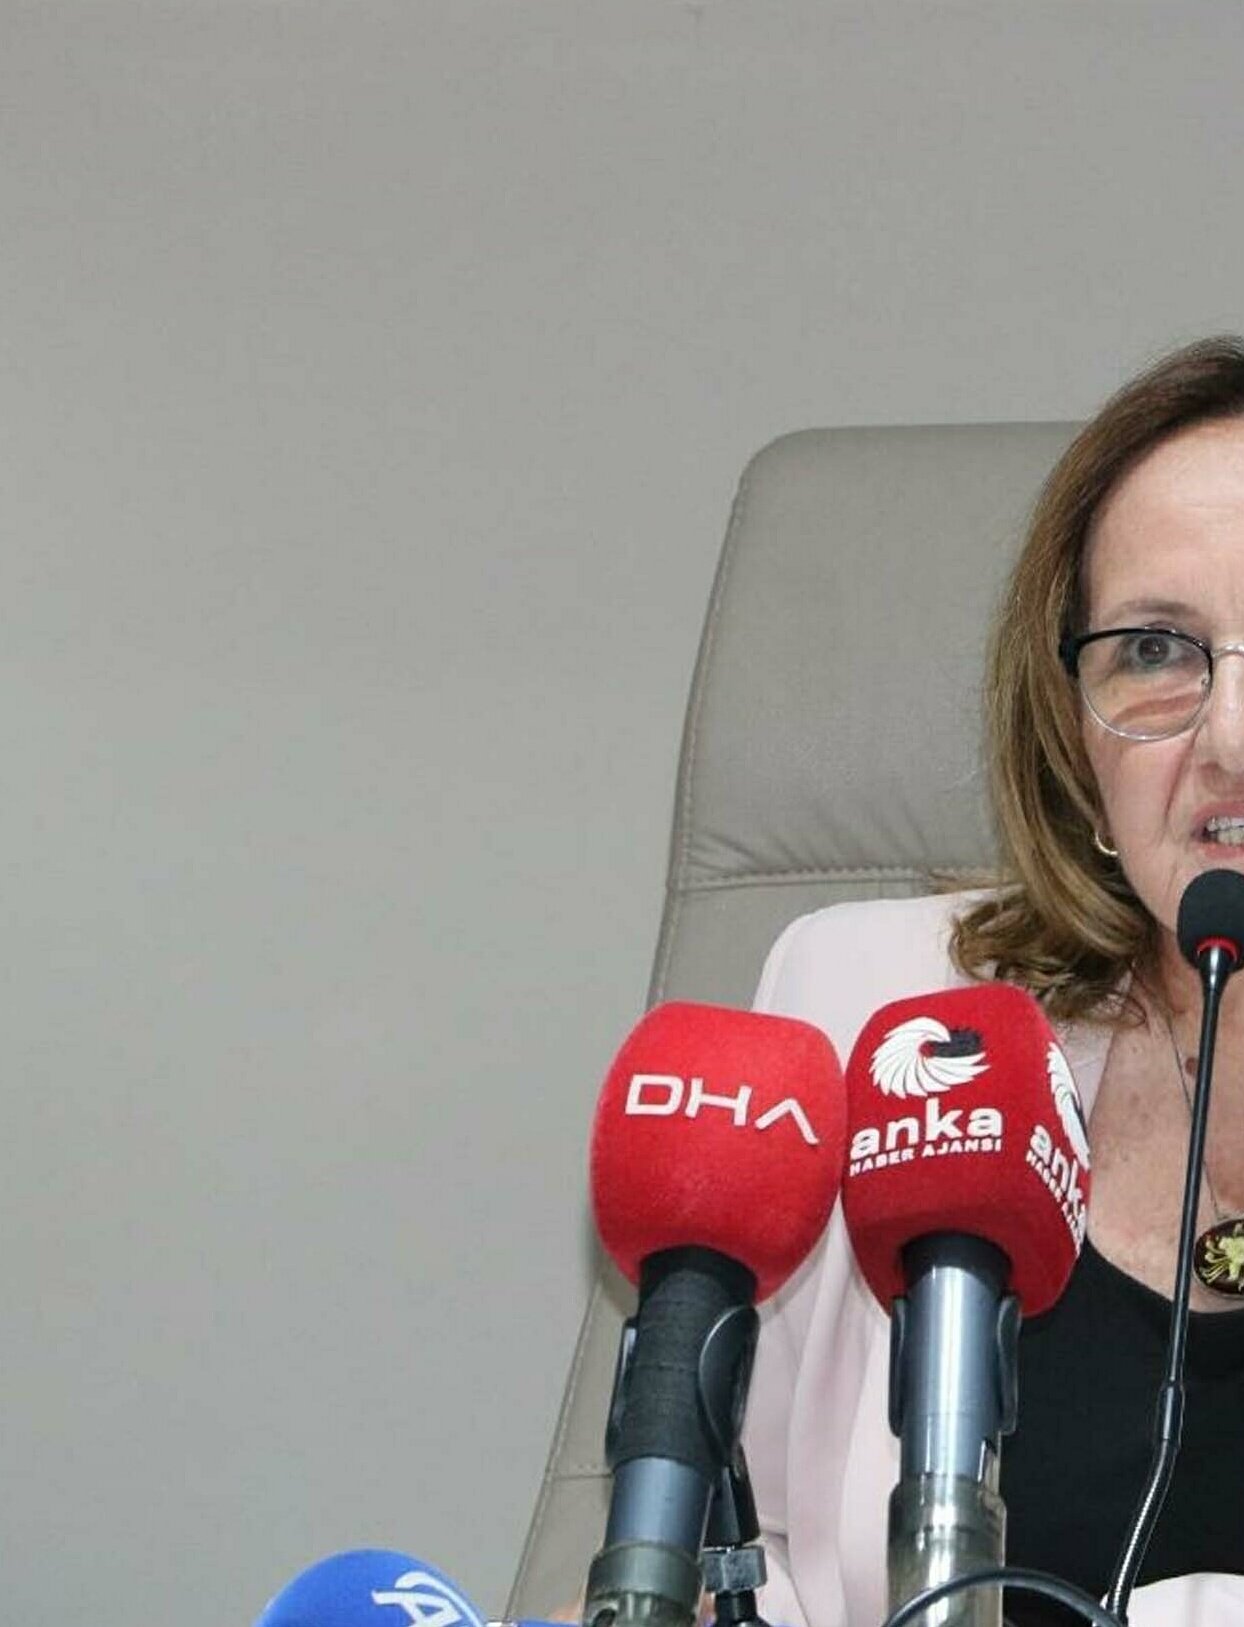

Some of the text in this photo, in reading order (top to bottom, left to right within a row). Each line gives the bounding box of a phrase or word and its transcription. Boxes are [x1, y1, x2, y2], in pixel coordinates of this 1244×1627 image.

[625, 1074, 819, 1146] DHA
[850, 1097, 1003, 1161] anka
[849, 1138, 1002, 1178] HABER AJANSI
